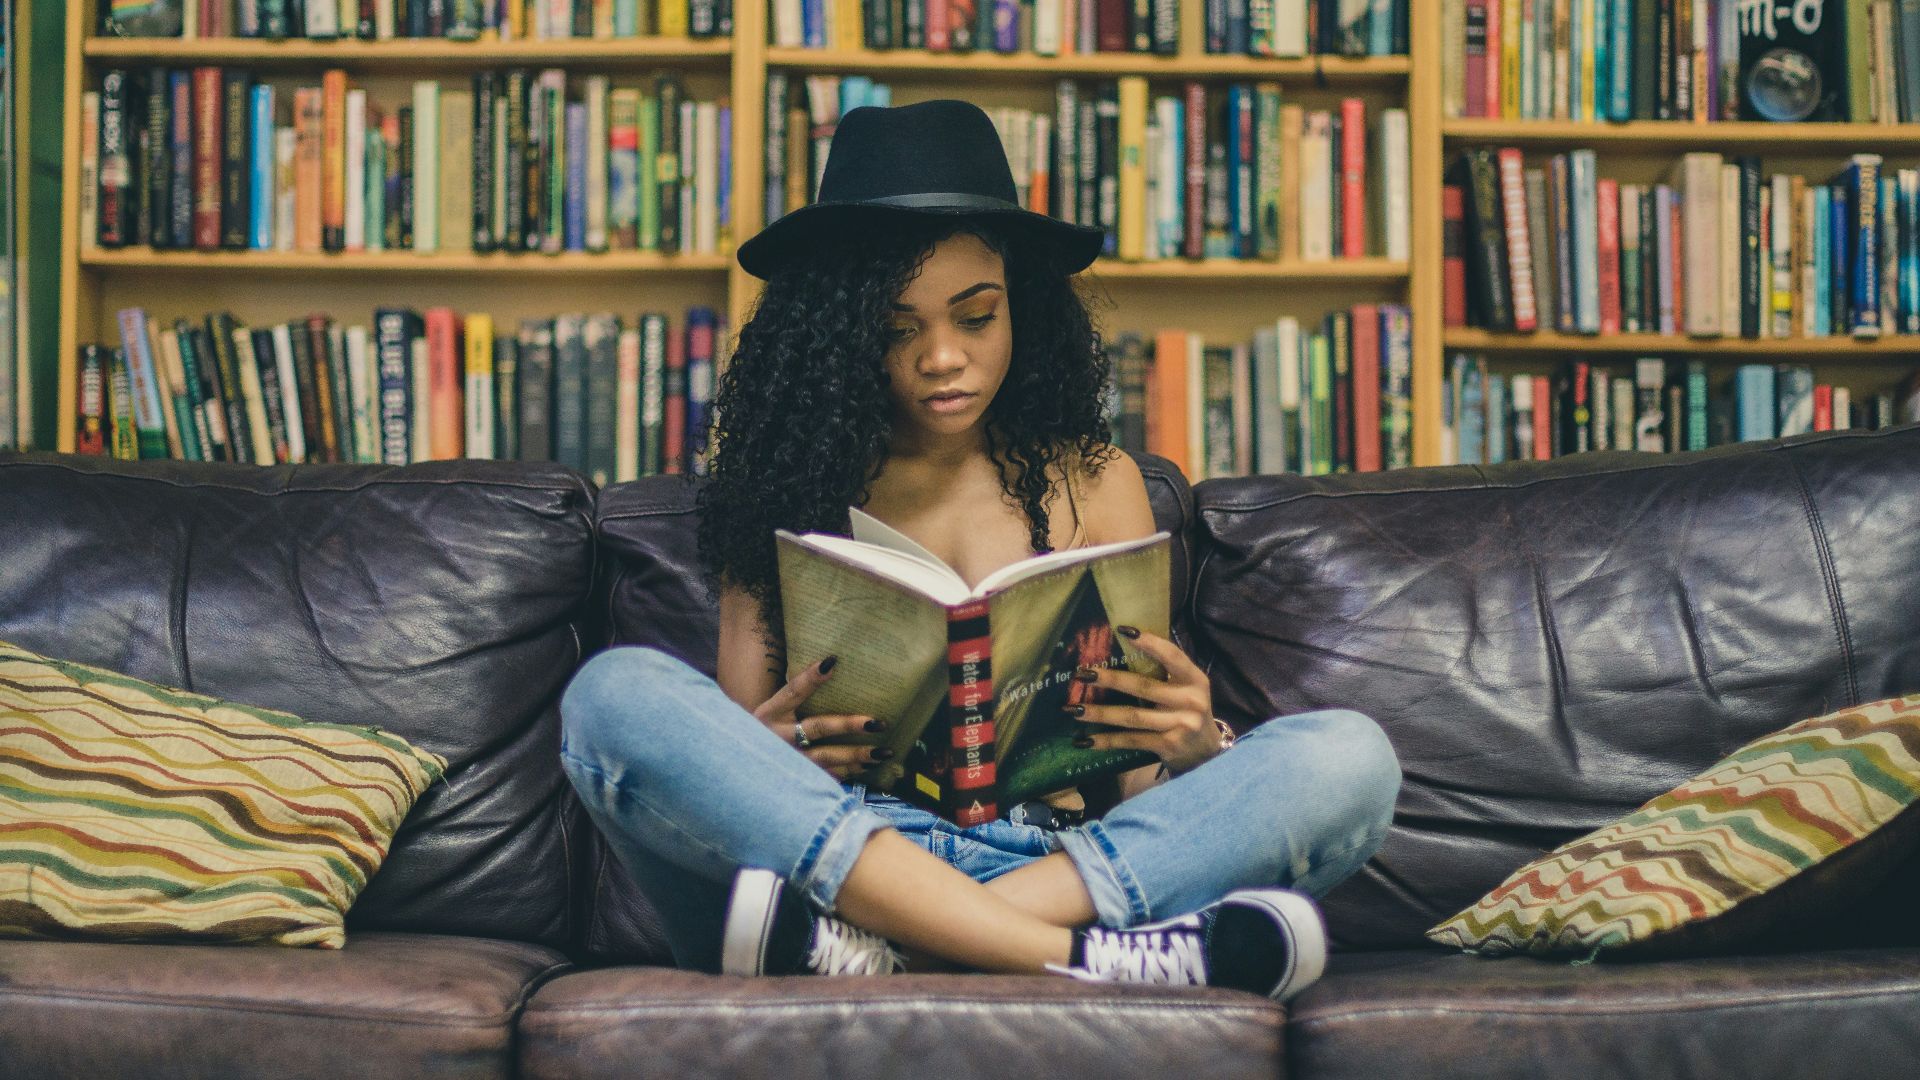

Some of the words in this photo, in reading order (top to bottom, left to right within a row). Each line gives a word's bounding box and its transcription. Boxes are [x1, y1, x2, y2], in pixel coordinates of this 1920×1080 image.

[379, 313, 404, 380] BLUE
[963, 651, 980, 689] Water
[1009, 676, 1050, 701] Water
[1056, 671, 1072, 684] for
[965, 692, 982, 711] for
[963, 715, 983, 779] Elephants
[1066, 761, 1099, 776] SARA
